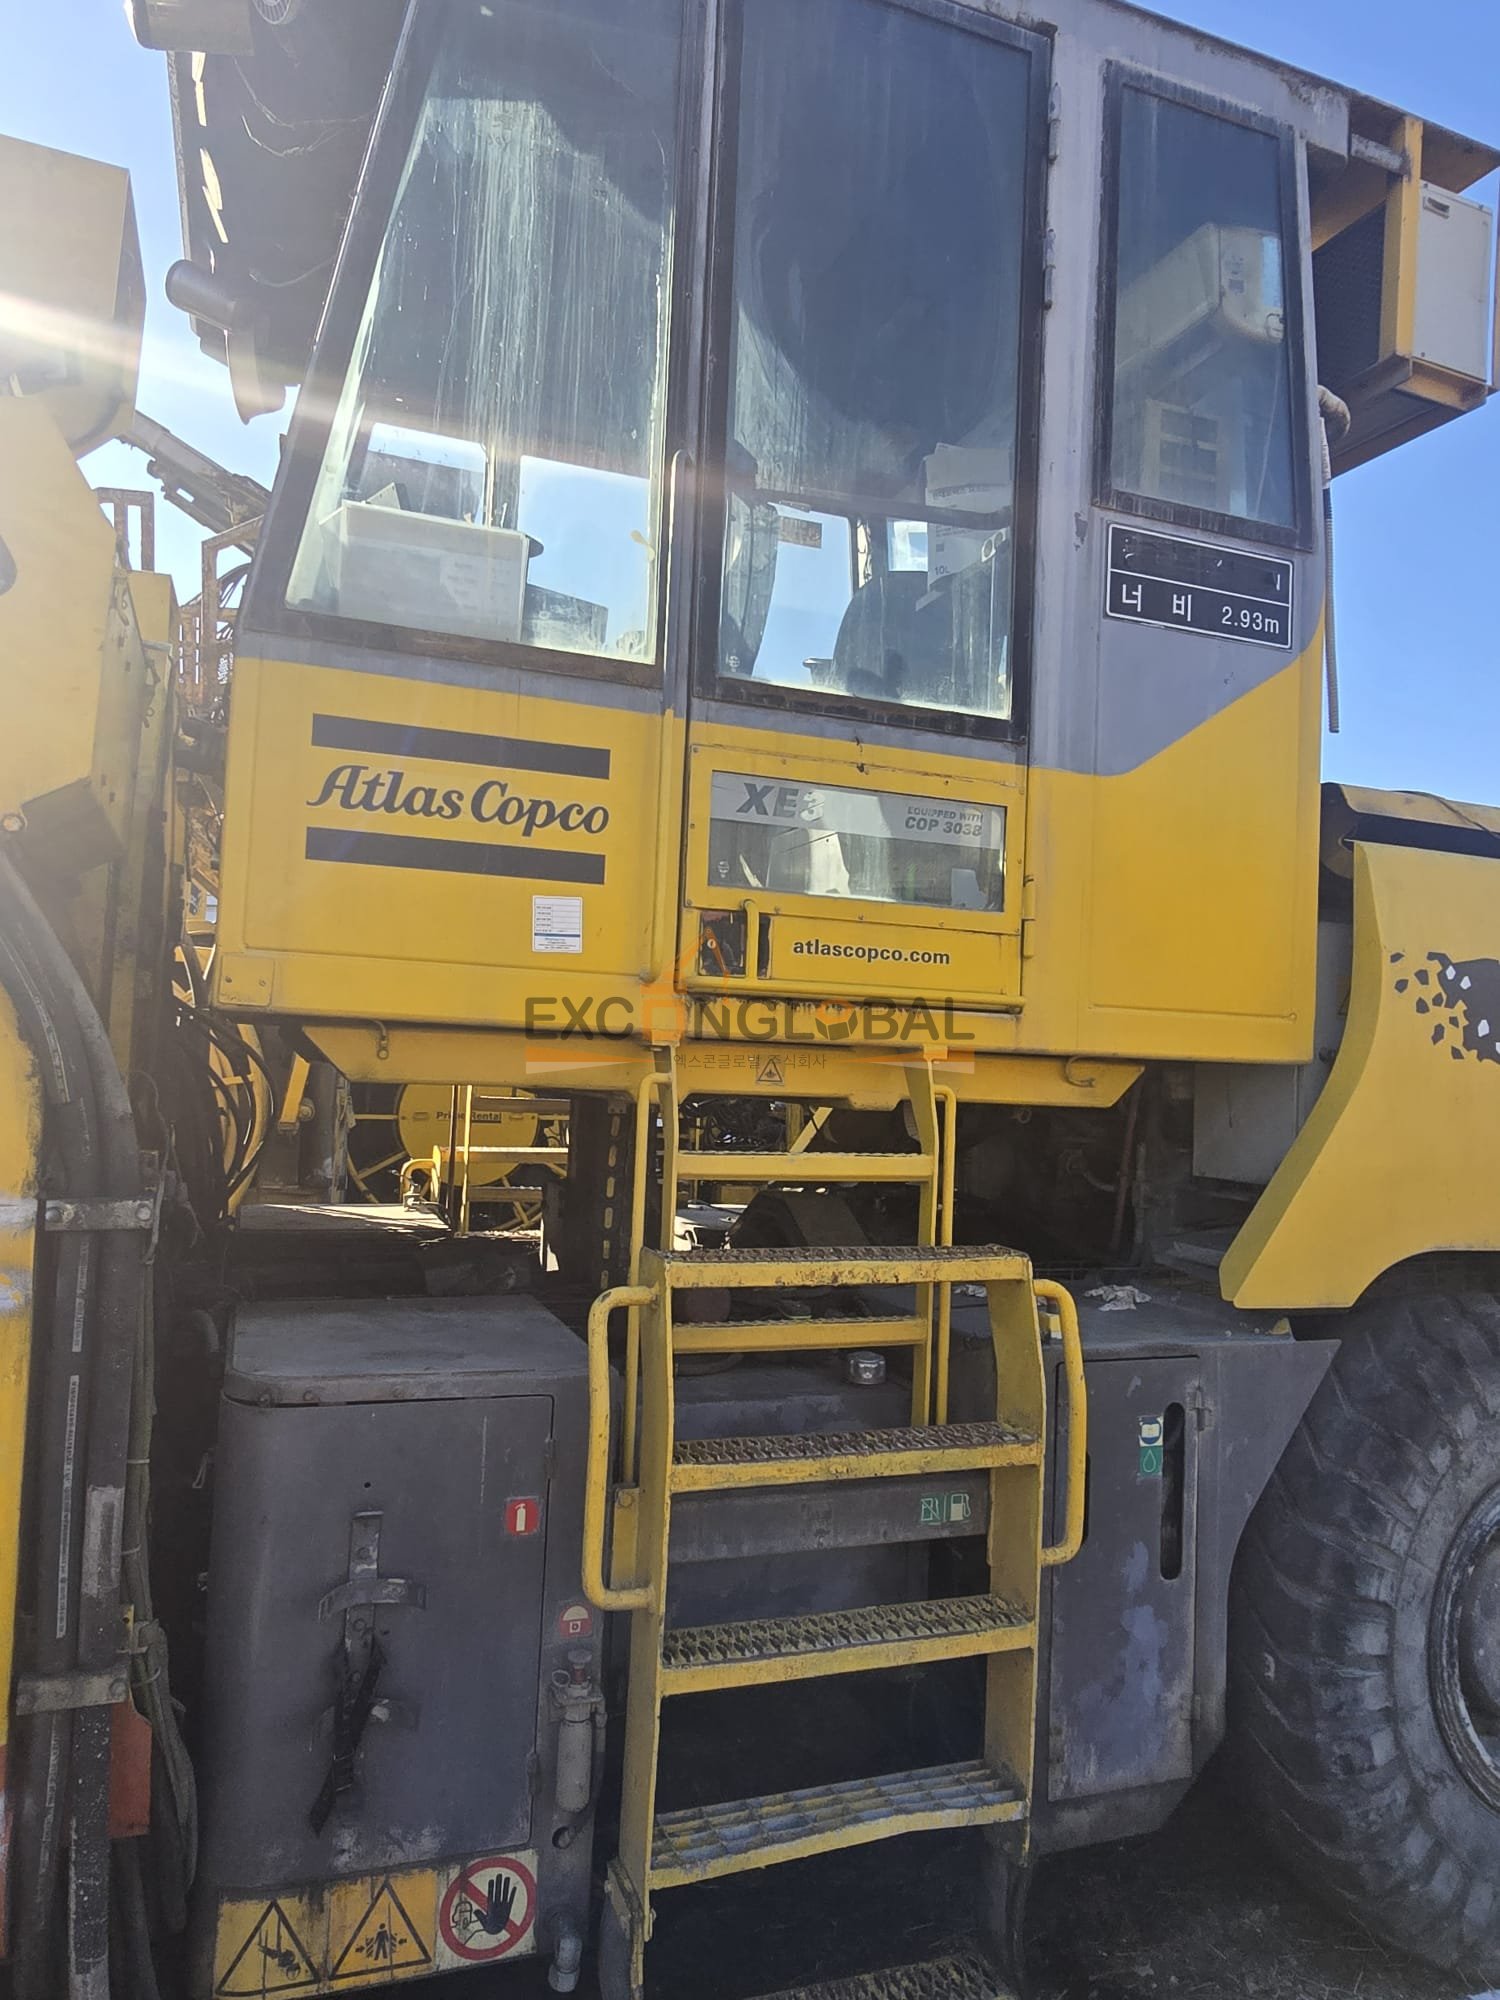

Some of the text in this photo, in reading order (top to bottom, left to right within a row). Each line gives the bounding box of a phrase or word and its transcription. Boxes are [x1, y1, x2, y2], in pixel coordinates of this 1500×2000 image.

[1220, 605, 1280, 634] 2.93m
[306, 764, 609, 837] Atlas Copco
[907, 806, 957, 820] EQUIPPED
[904, 815, 983, 837] COP 3038
[793, 938, 950, 965] atlascopco.com
